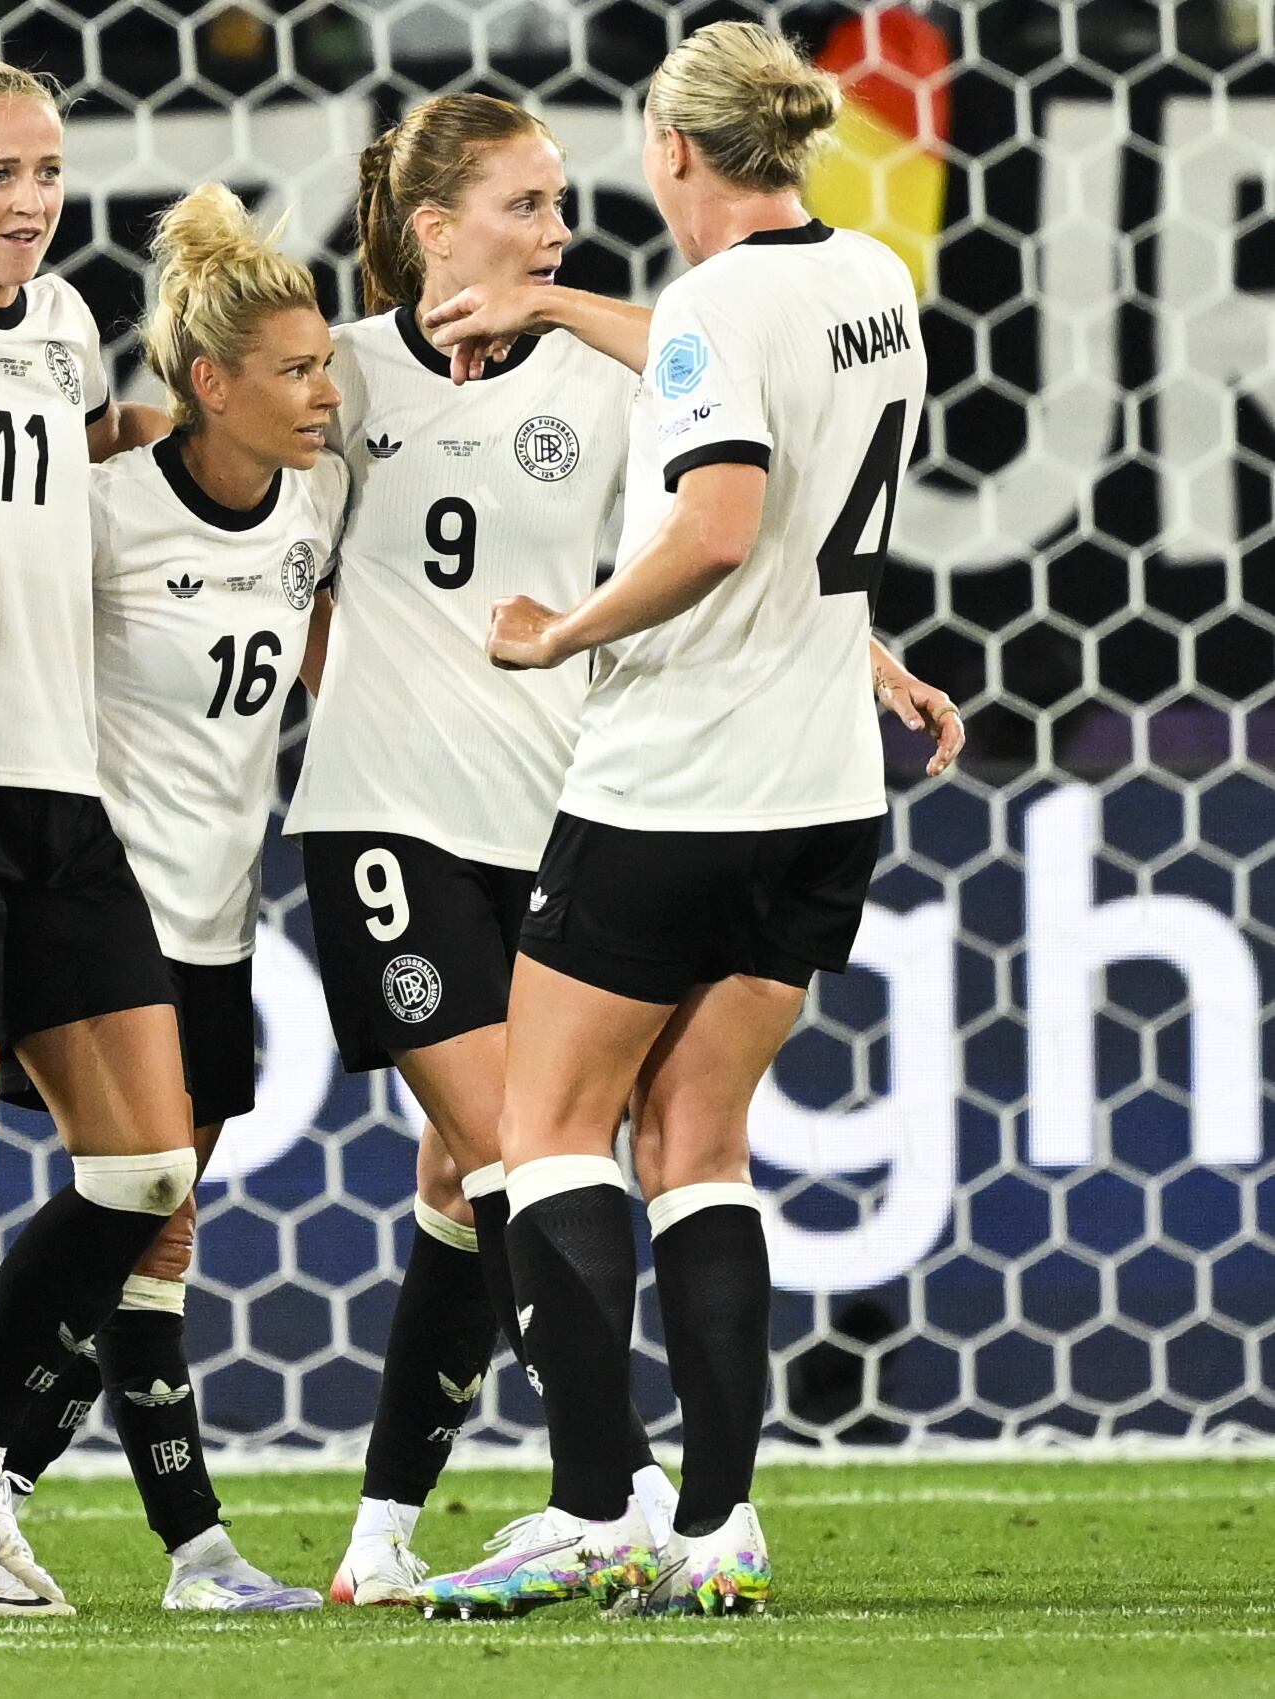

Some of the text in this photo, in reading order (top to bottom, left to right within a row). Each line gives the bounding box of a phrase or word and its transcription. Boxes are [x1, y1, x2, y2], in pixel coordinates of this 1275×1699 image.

[827, 304, 910, 373] KNAAK
[423, 496, 477, 590] 9
[816, 399, 907, 619] 4
[206, 630, 282, 719] 16
[355, 847, 410, 942] 9
